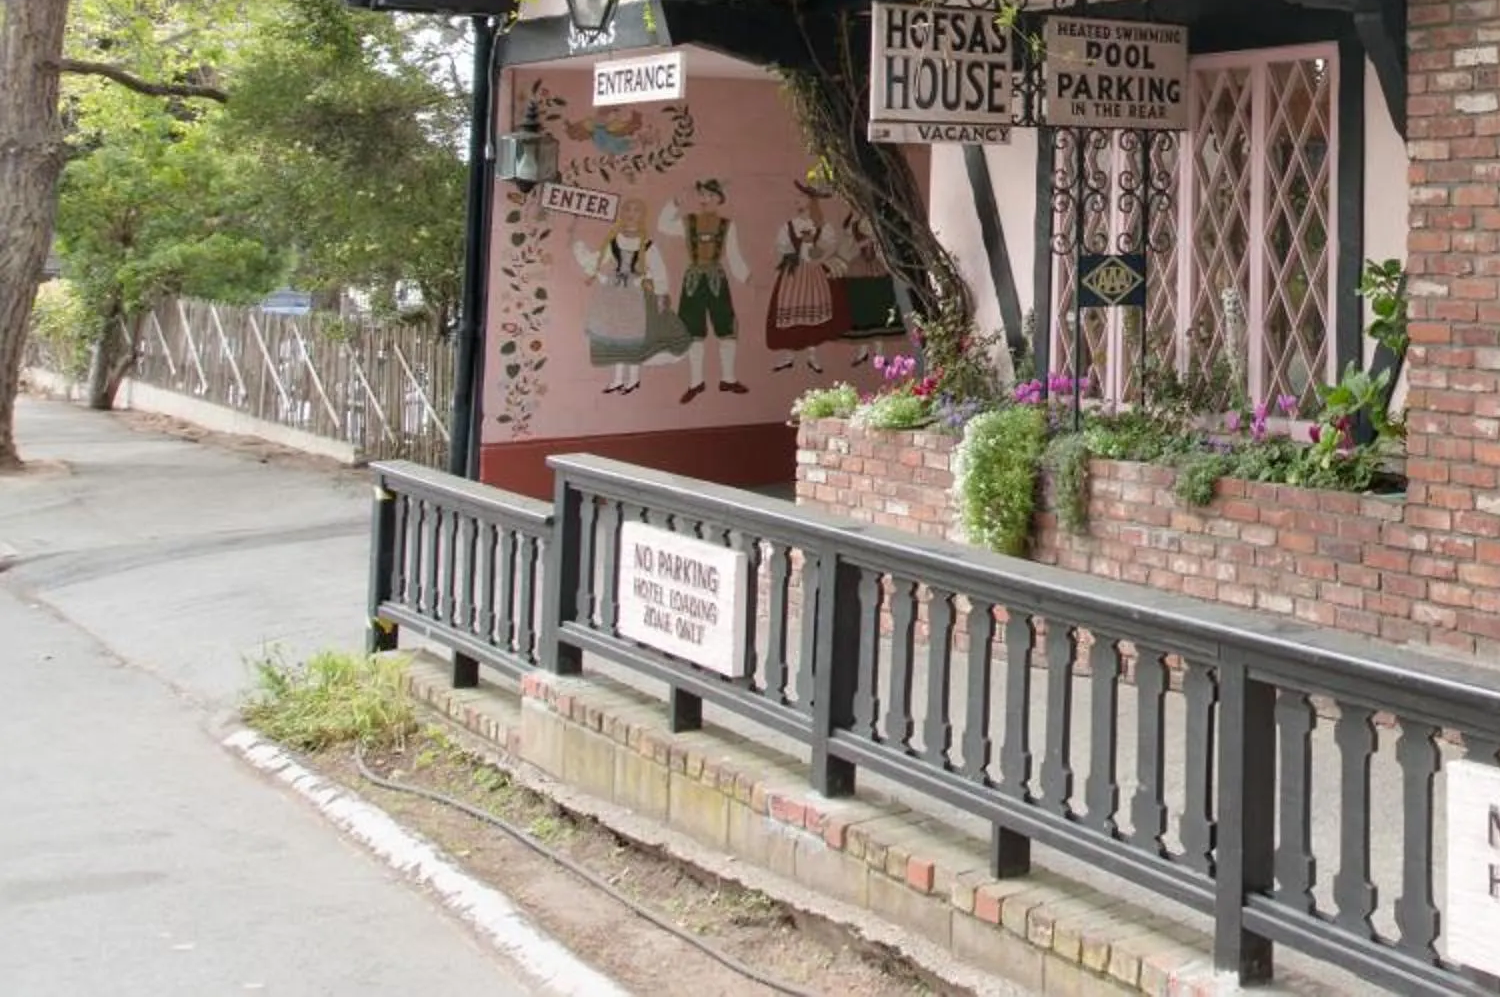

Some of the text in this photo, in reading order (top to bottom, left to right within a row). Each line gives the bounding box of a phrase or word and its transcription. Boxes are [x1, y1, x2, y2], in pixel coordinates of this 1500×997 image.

[886, 7, 1007, 55] HOFSAS
[1057, 23, 1180, 44] HEATED SWIMMING
[1086, 41, 1155, 69] POOL
[597, 63, 677, 95] ENTRANCE
[885, 55, 1007, 113] HOUSE
[1057, 73, 1180, 103] PARKING
[1071, 102, 1168, 120] IN THE REAR
[917, 125, 1011, 142] VACANCY
[549, 188, 609, 217] ENTER
[634, 543, 719, 594] NO PARKING
[634, 577, 718, 626] HOTEL LOADING
[643, 605, 706, 645] ZONE ONLY
